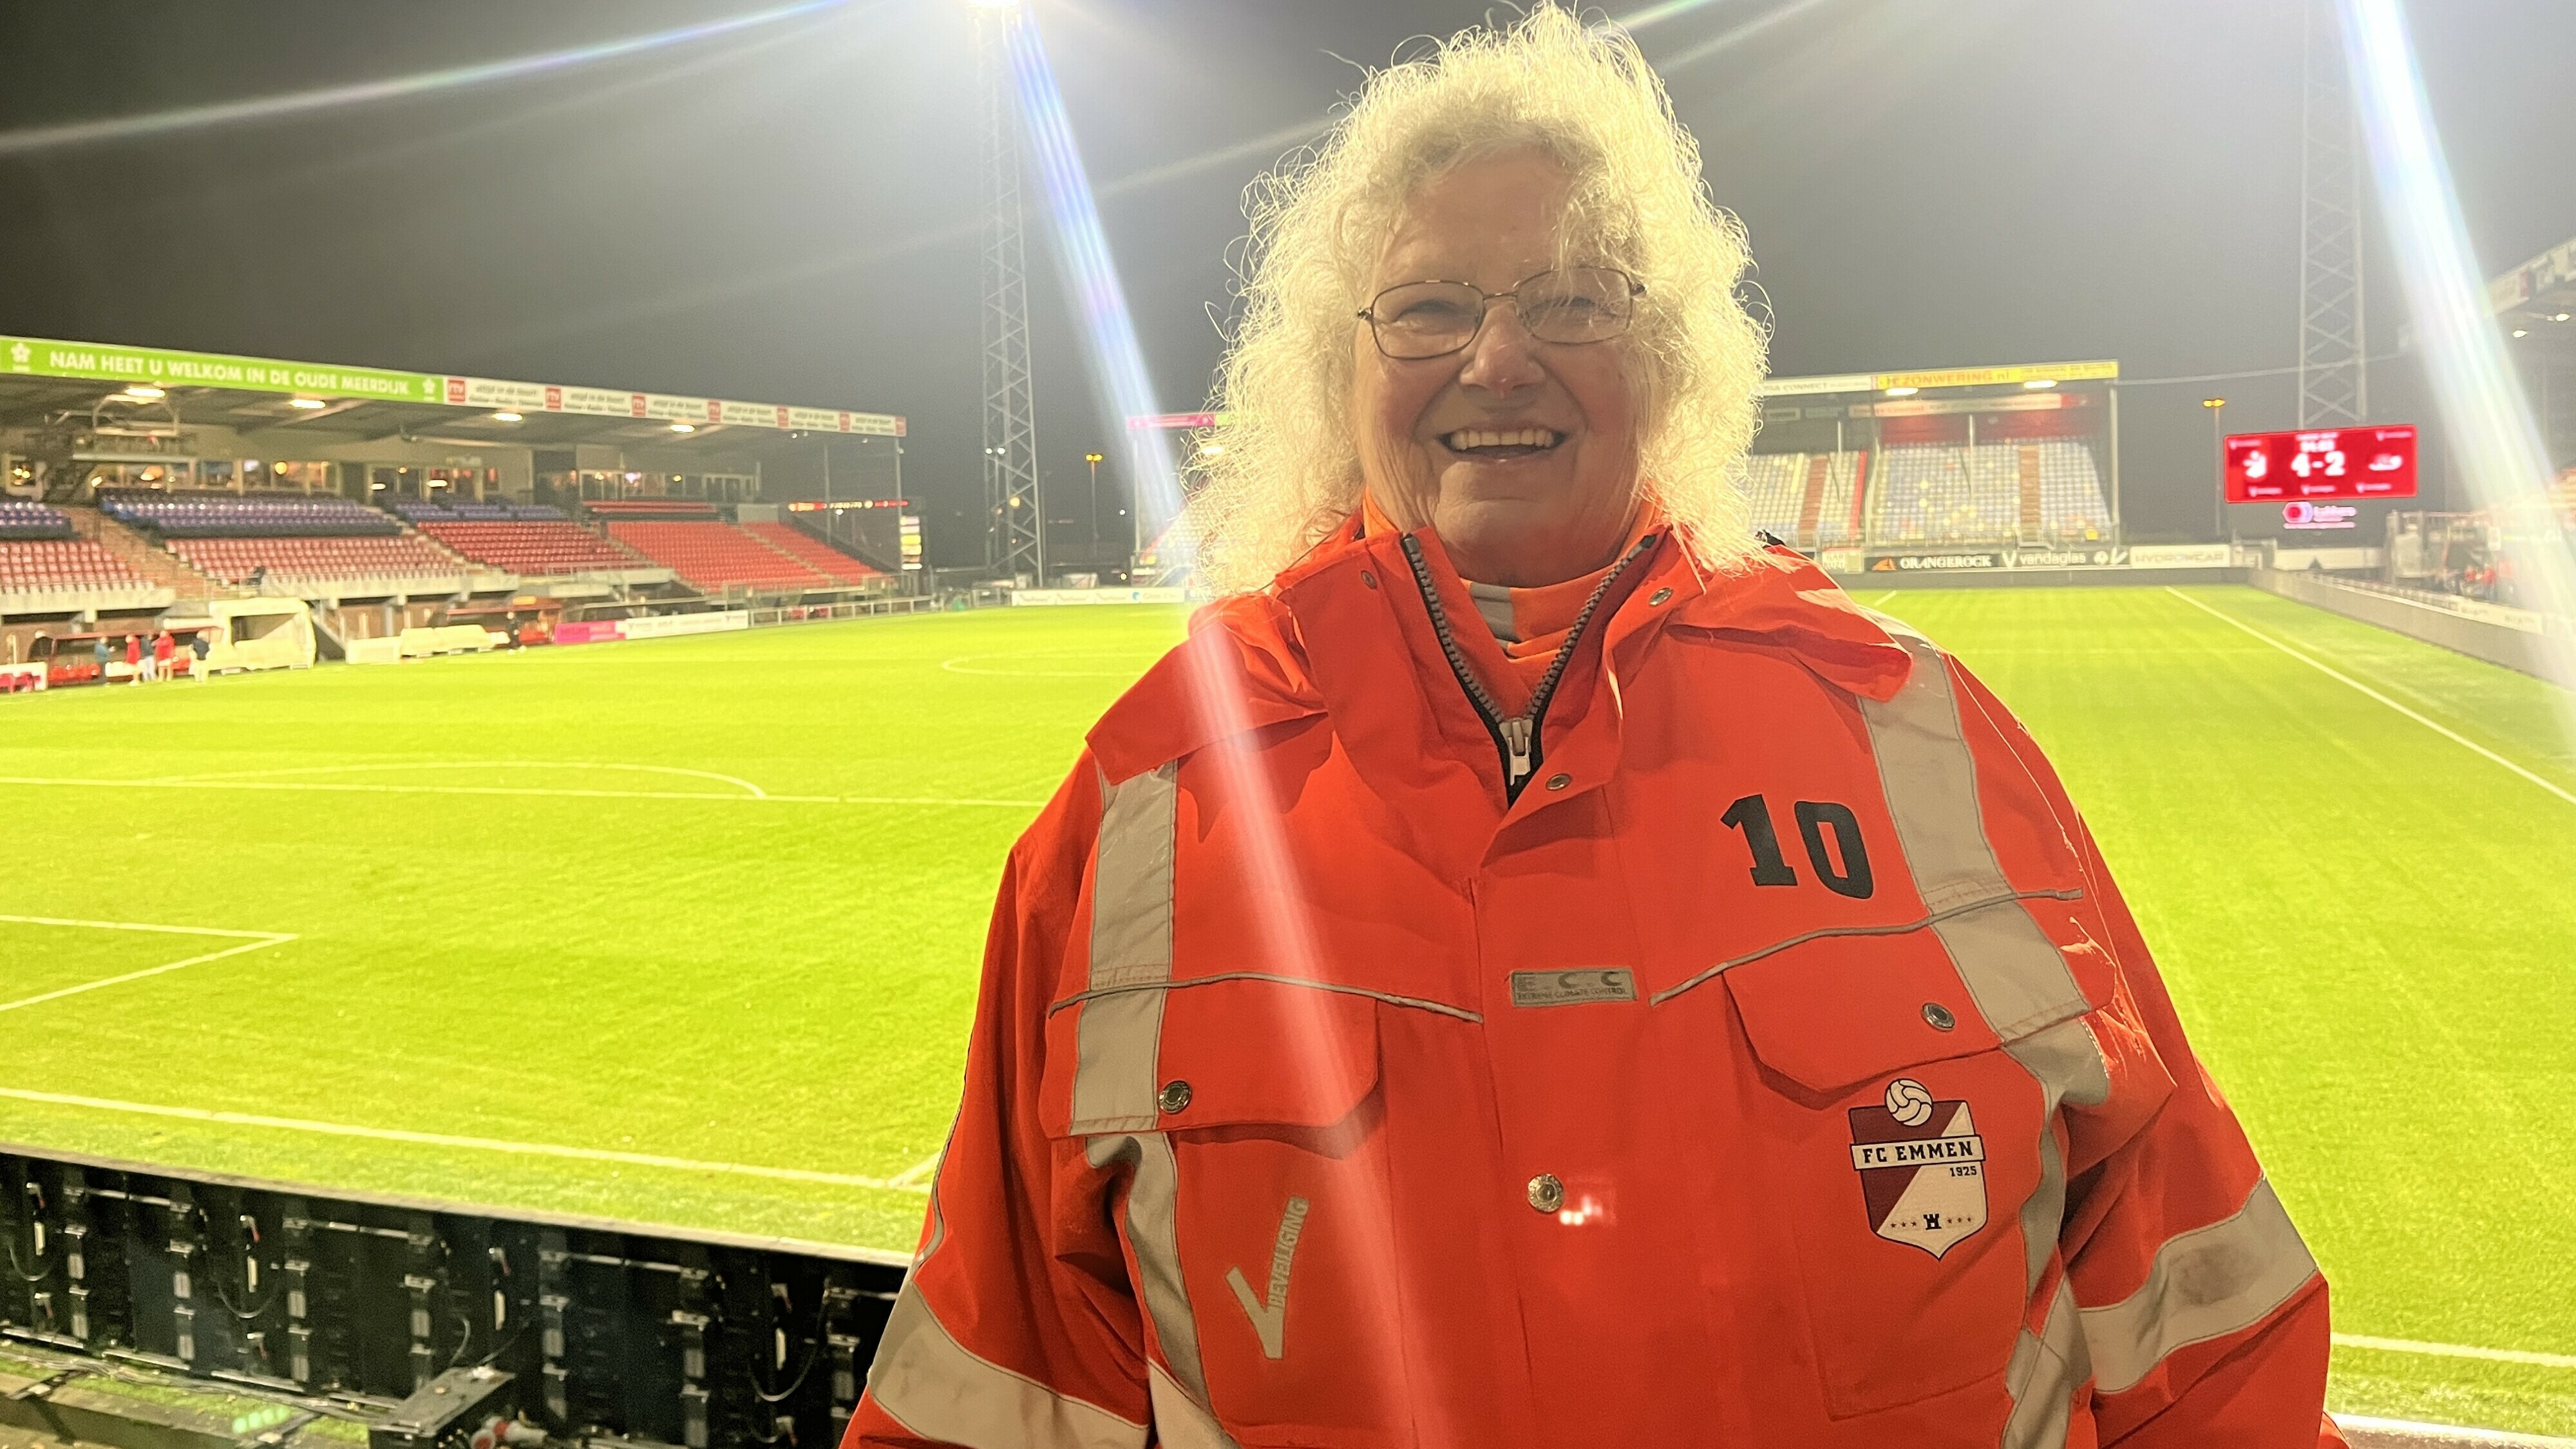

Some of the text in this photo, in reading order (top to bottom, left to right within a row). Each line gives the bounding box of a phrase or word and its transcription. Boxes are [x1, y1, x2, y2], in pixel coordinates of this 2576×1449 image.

[50, 350, 96, 370] NAM
[100, 355, 144, 374] HEET
[149, 359, 164, 376] U
[167, 361, 242, 382] WELKOM
[246, 368, 265, 384] IN
[270, 370, 290, 386] DE
[294, 371, 337, 389] OUDE
[341, 376, 410, 394] MEERDIJK
[1900, 555, 1992, 569] ORANGEROCK
[2020, 551, 2087, 566] vandaglas
[1720, 794, 1873, 900] 10
[1862, 1141, 1973, 1164] FC EMMEN
[1949, 1166, 1978, 1177] 1925
